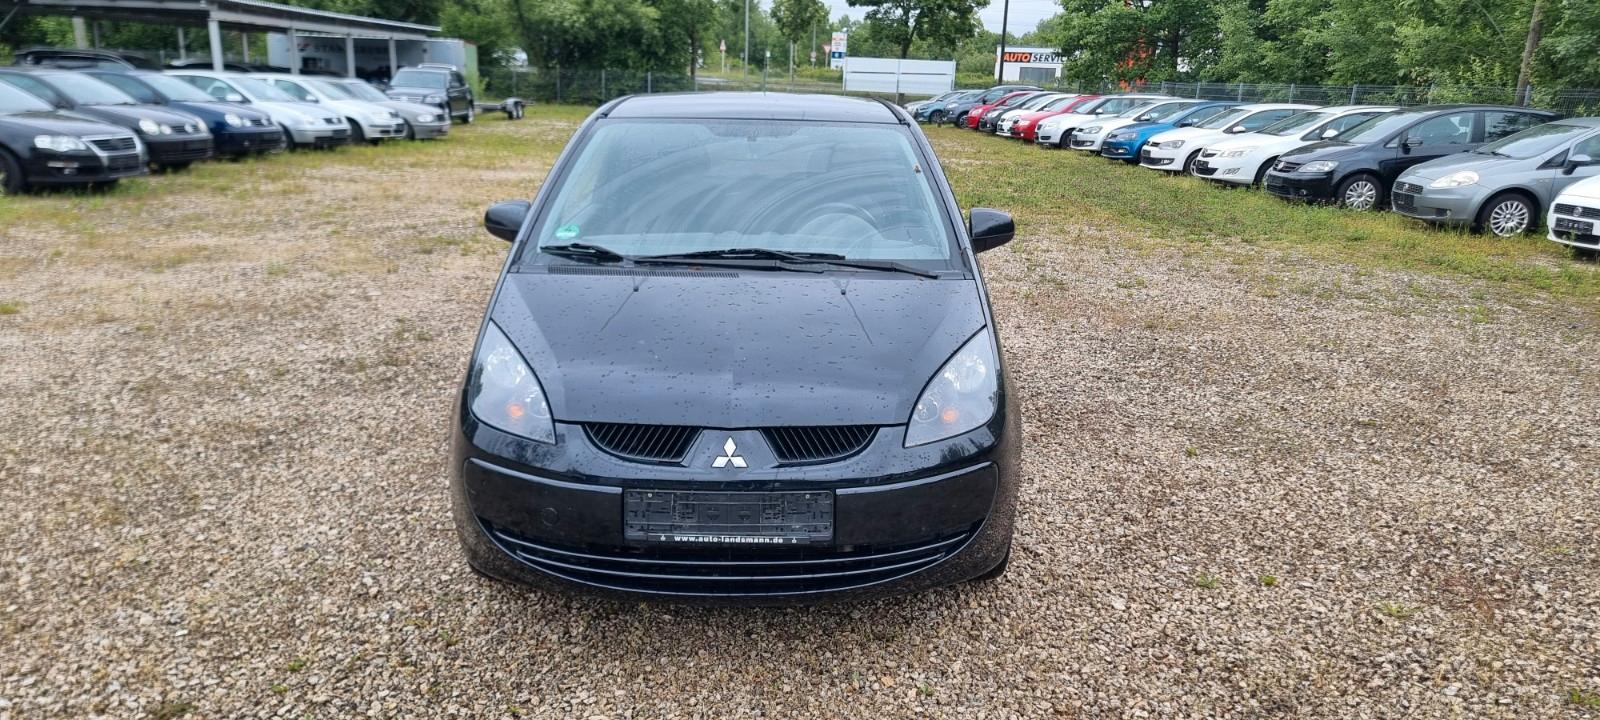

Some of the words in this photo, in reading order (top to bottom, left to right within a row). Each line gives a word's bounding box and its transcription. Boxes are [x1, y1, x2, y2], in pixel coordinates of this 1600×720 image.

[1003, 53, 1030, 62] AUTO
[1032, 53, 1066, 63] SERVIC
[674, 535, 784, 544] www.auto-landsmann.de
